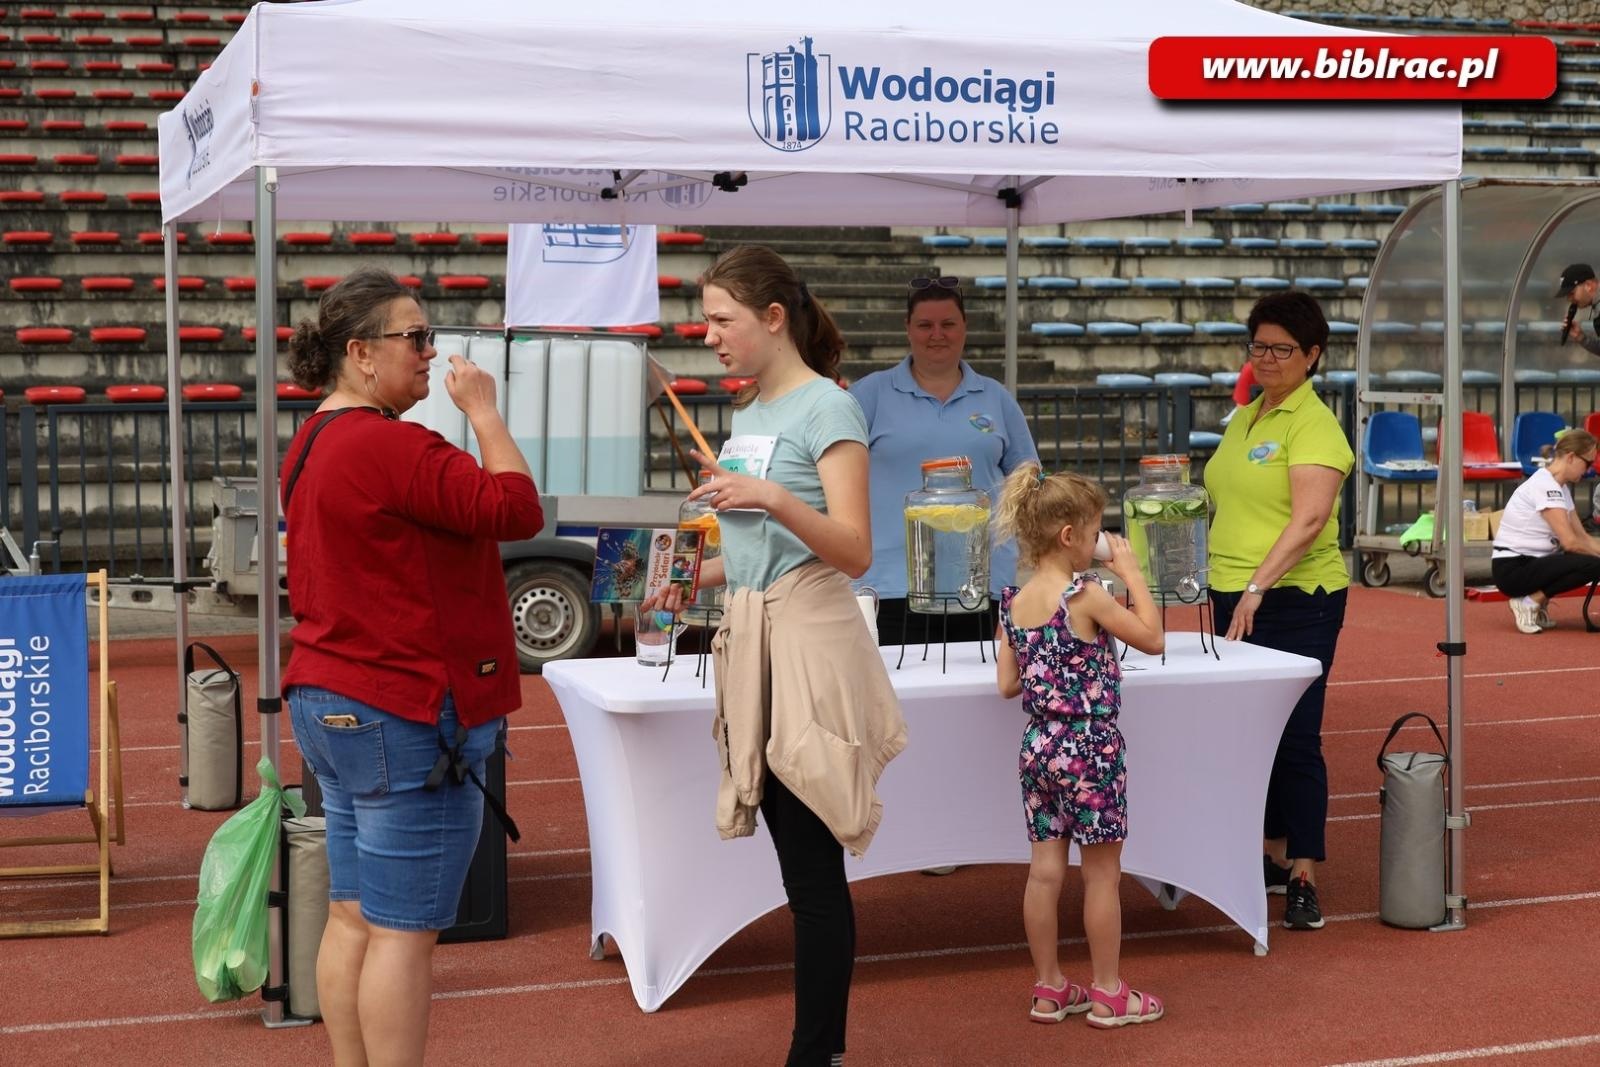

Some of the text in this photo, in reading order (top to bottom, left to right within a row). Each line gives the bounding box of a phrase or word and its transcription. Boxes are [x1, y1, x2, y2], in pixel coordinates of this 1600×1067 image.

[838, 66, 1055, 113] Wodociągi
[844, 111, 1059, 144] Raciborskie
[24, 635, 50, 795] Raciborskie
